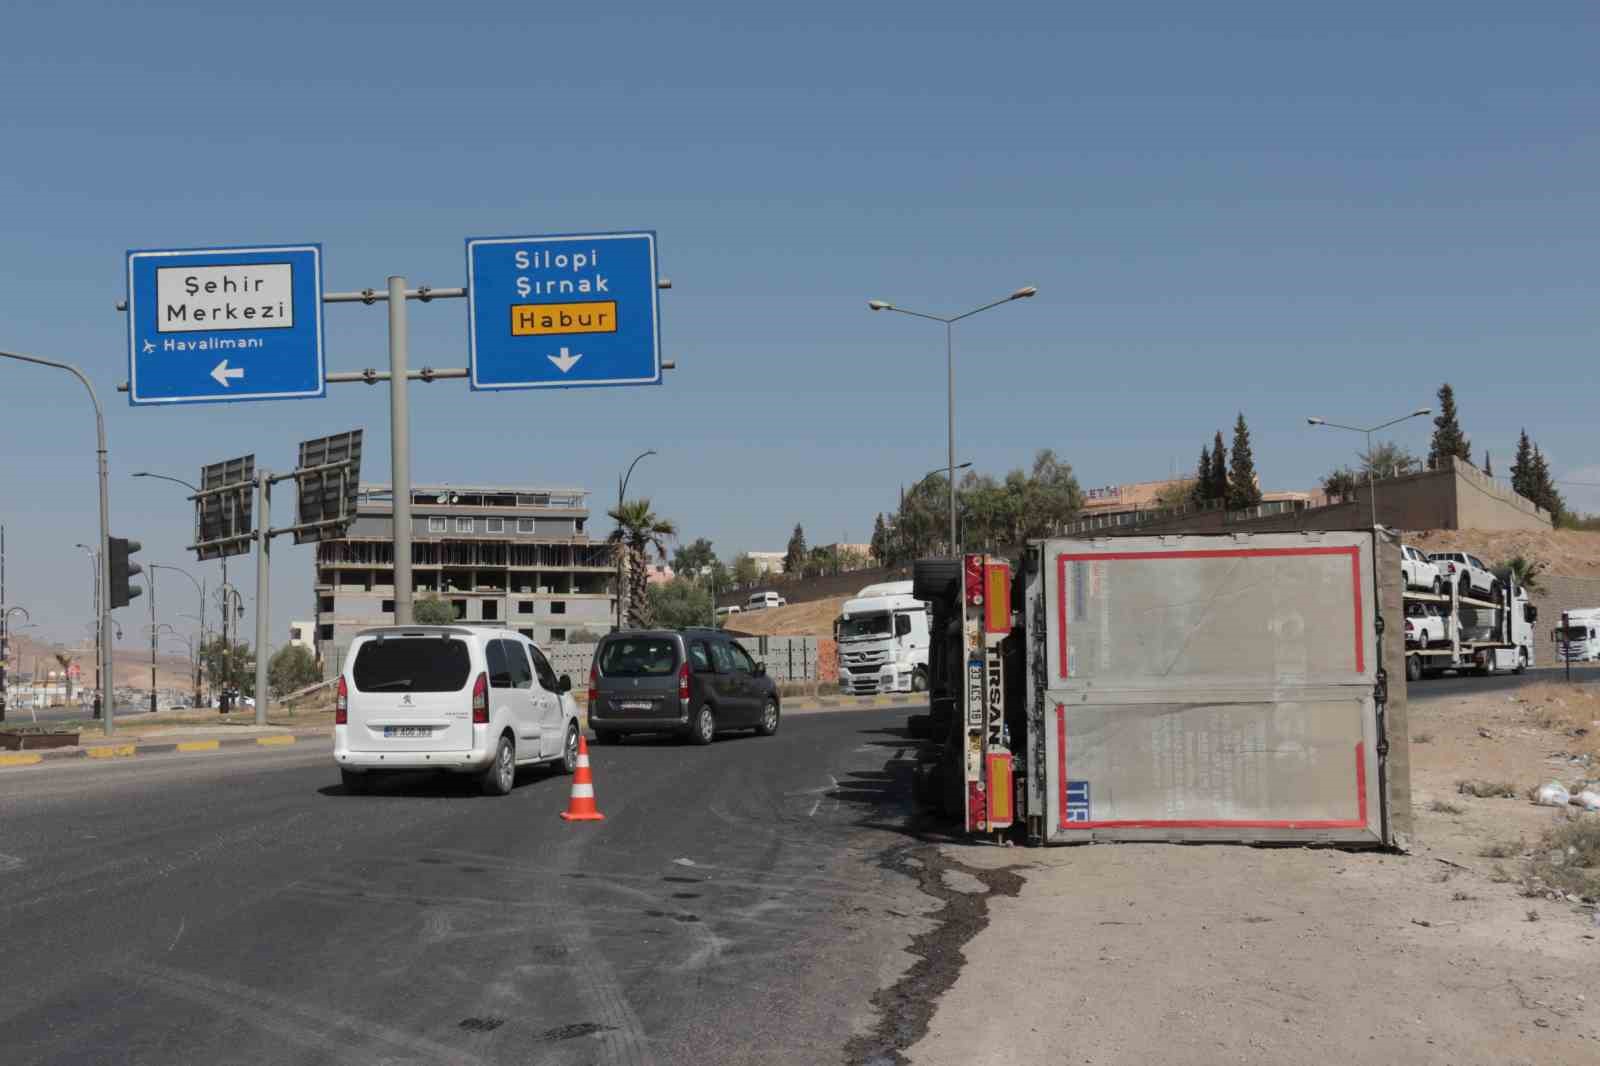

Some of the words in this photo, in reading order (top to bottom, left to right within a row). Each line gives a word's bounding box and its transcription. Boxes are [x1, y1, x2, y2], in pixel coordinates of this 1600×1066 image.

[515, 250, 597, 272] Silopi
[184, 276, 264, 296] Şehir
[516, 274, 609, 298] Şırnak
[167, 302, 284, 322] Merkezi
[519, 310, 608, 329] Habur
[986, 641, 1001, 744] TIRSAN
[1066, 783, 1089, 822] TIR
